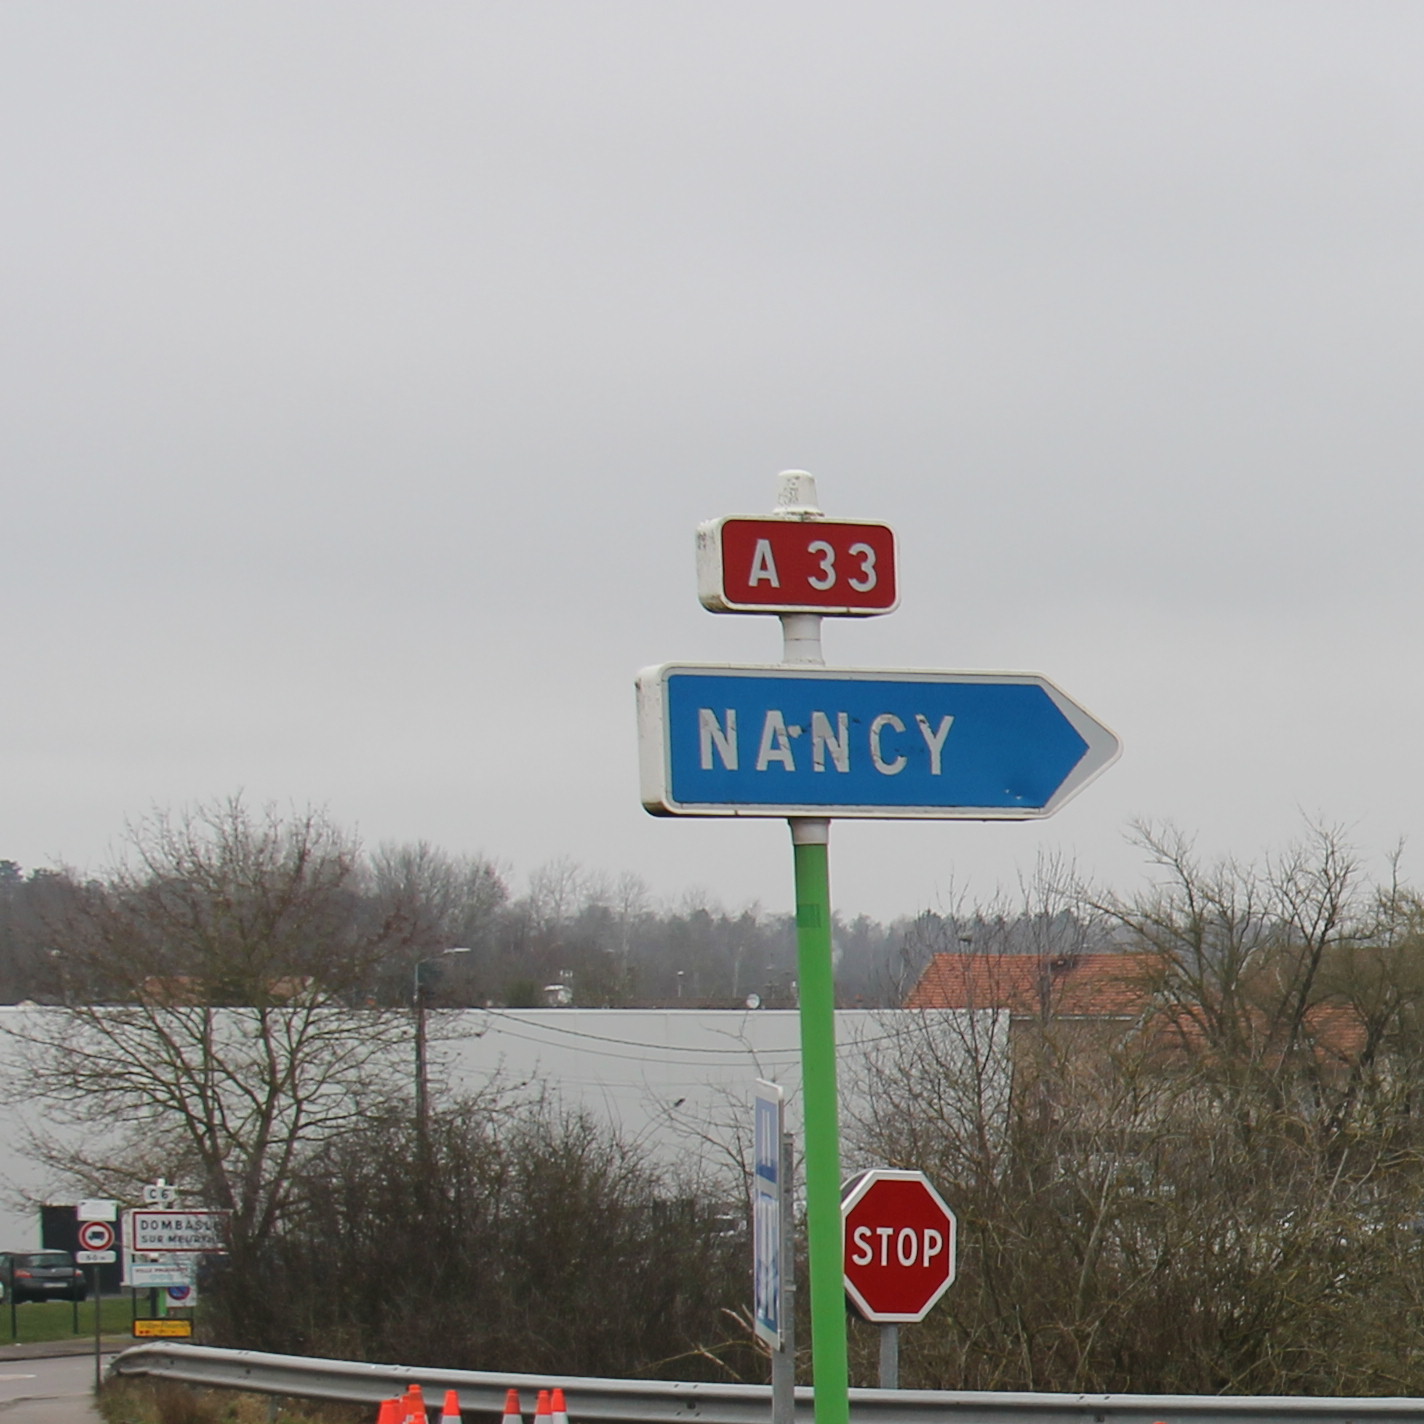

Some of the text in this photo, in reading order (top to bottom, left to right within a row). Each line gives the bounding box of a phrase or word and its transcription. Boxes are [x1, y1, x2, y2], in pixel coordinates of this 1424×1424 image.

[748, 539, 878, 592] A 33
[699, 707, 955, 775] NANCY
[149, 1189, 169, 1199] C 6
[141, 1235, 163, 1243] SUR
[852, 1226, 943, 1267] STOP
